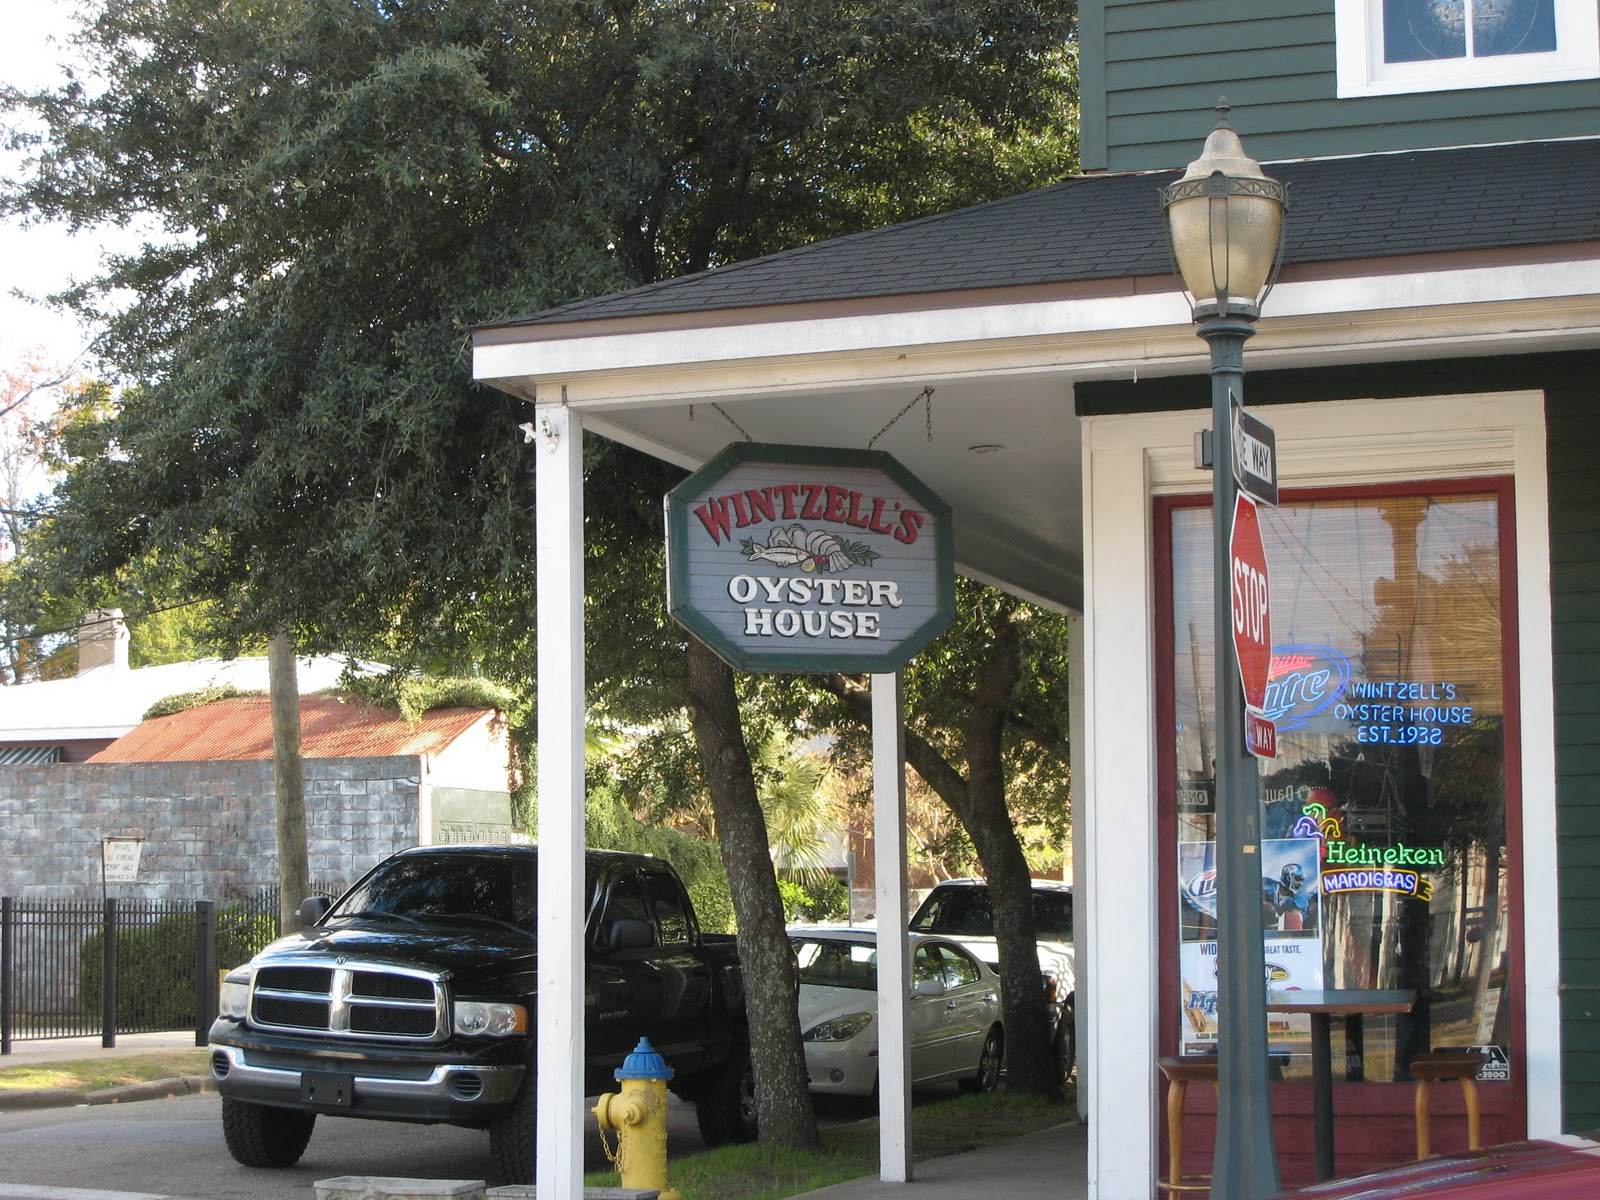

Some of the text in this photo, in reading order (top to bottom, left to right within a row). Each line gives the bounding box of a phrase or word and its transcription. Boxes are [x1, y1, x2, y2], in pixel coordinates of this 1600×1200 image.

[1251, 441, 1269, 478] WAY
[693, 484, 925, 547] WINTZELL'S
[727, 574, 903, 608] OYSTER
[1234, 556, 1268, 645] STOP
[743, 608, 881, 638] HOUSE
[1352, 682, 1456, 700] WINTZELL'S
[1334, 704, 1473, 723] OYSTER HOUSE
[1255, 724, 1273, 751] WAY
[1326, 841, 1445, 865] Heineken
[1200, 943, 1217, 955] WID
[1282, 945, 1302, 953] TASTE.
